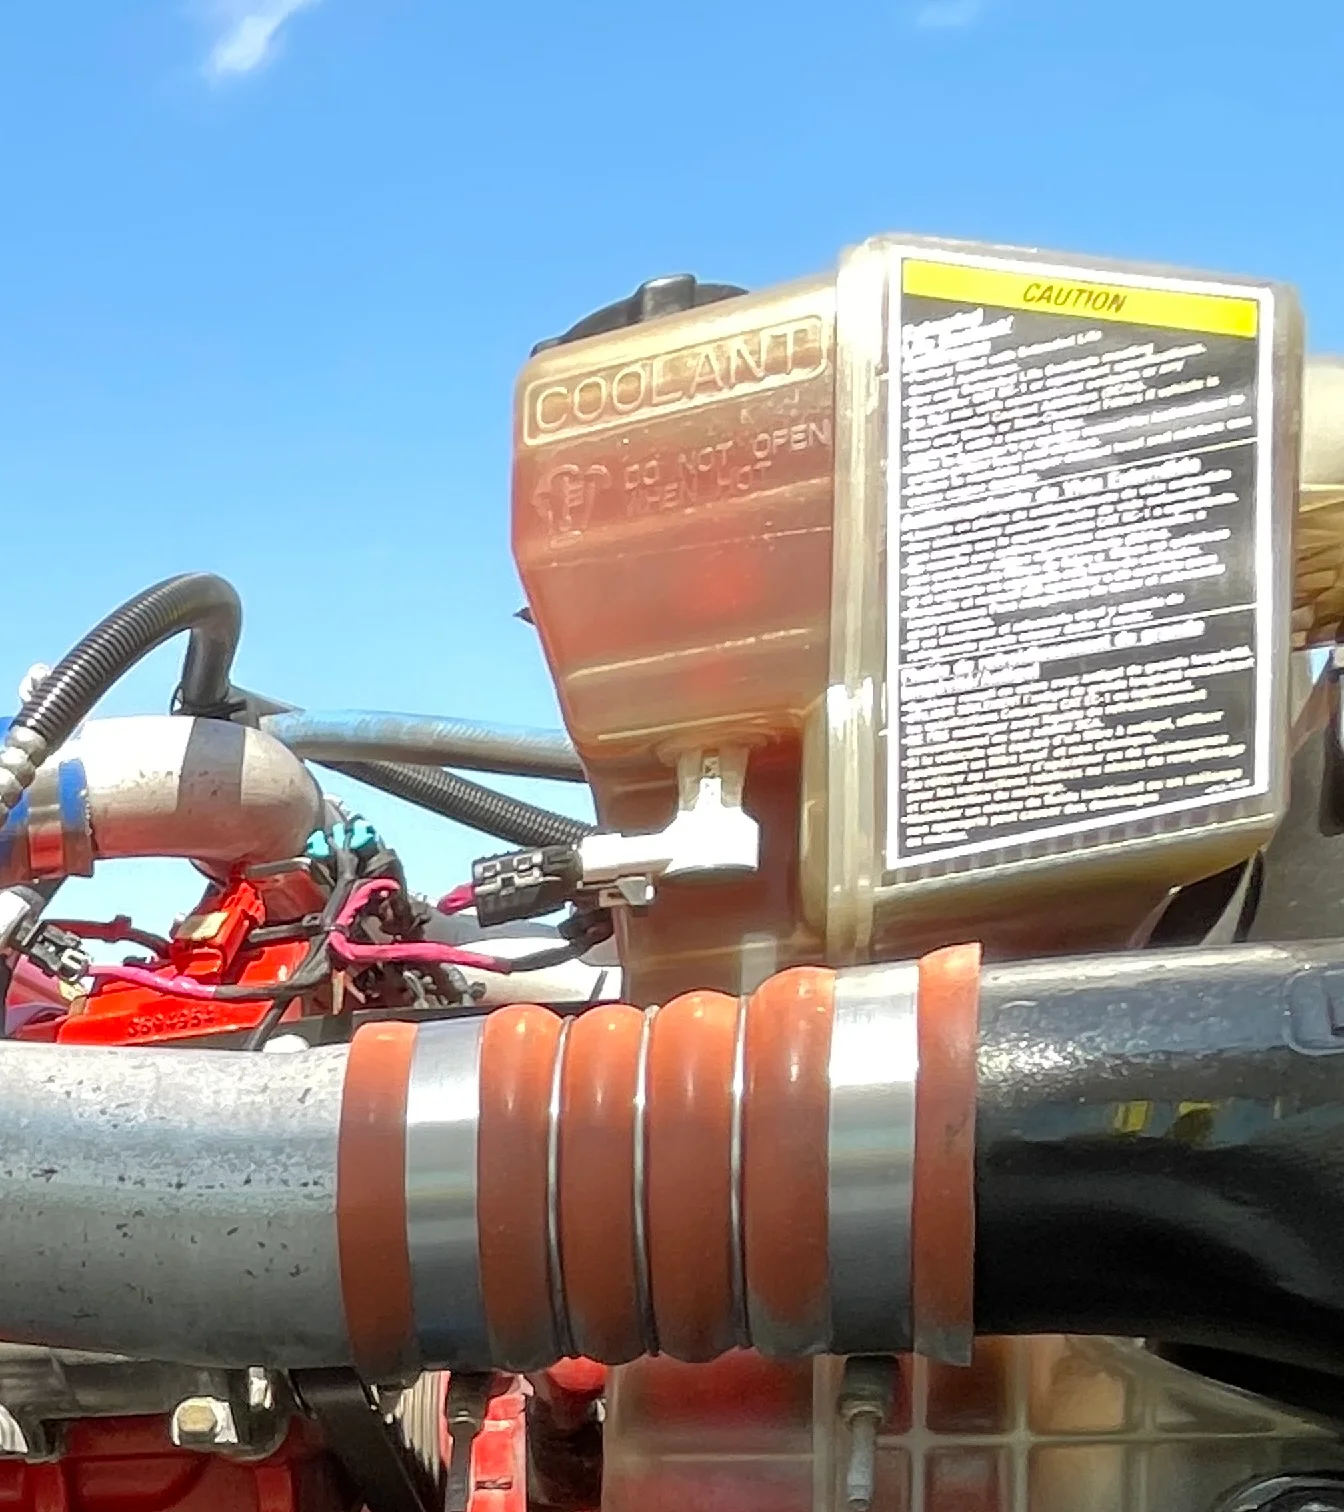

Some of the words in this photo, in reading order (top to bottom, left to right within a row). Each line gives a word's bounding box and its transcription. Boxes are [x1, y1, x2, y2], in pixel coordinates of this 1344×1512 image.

[1023, 282, 1127, 314] CAUTION
[536, 327, 809, 430] COOLANT
[624, 461, 660, 490] DO
[678, 440, 735, 476] NOT
[751, 419, 831, 459] OPEN
